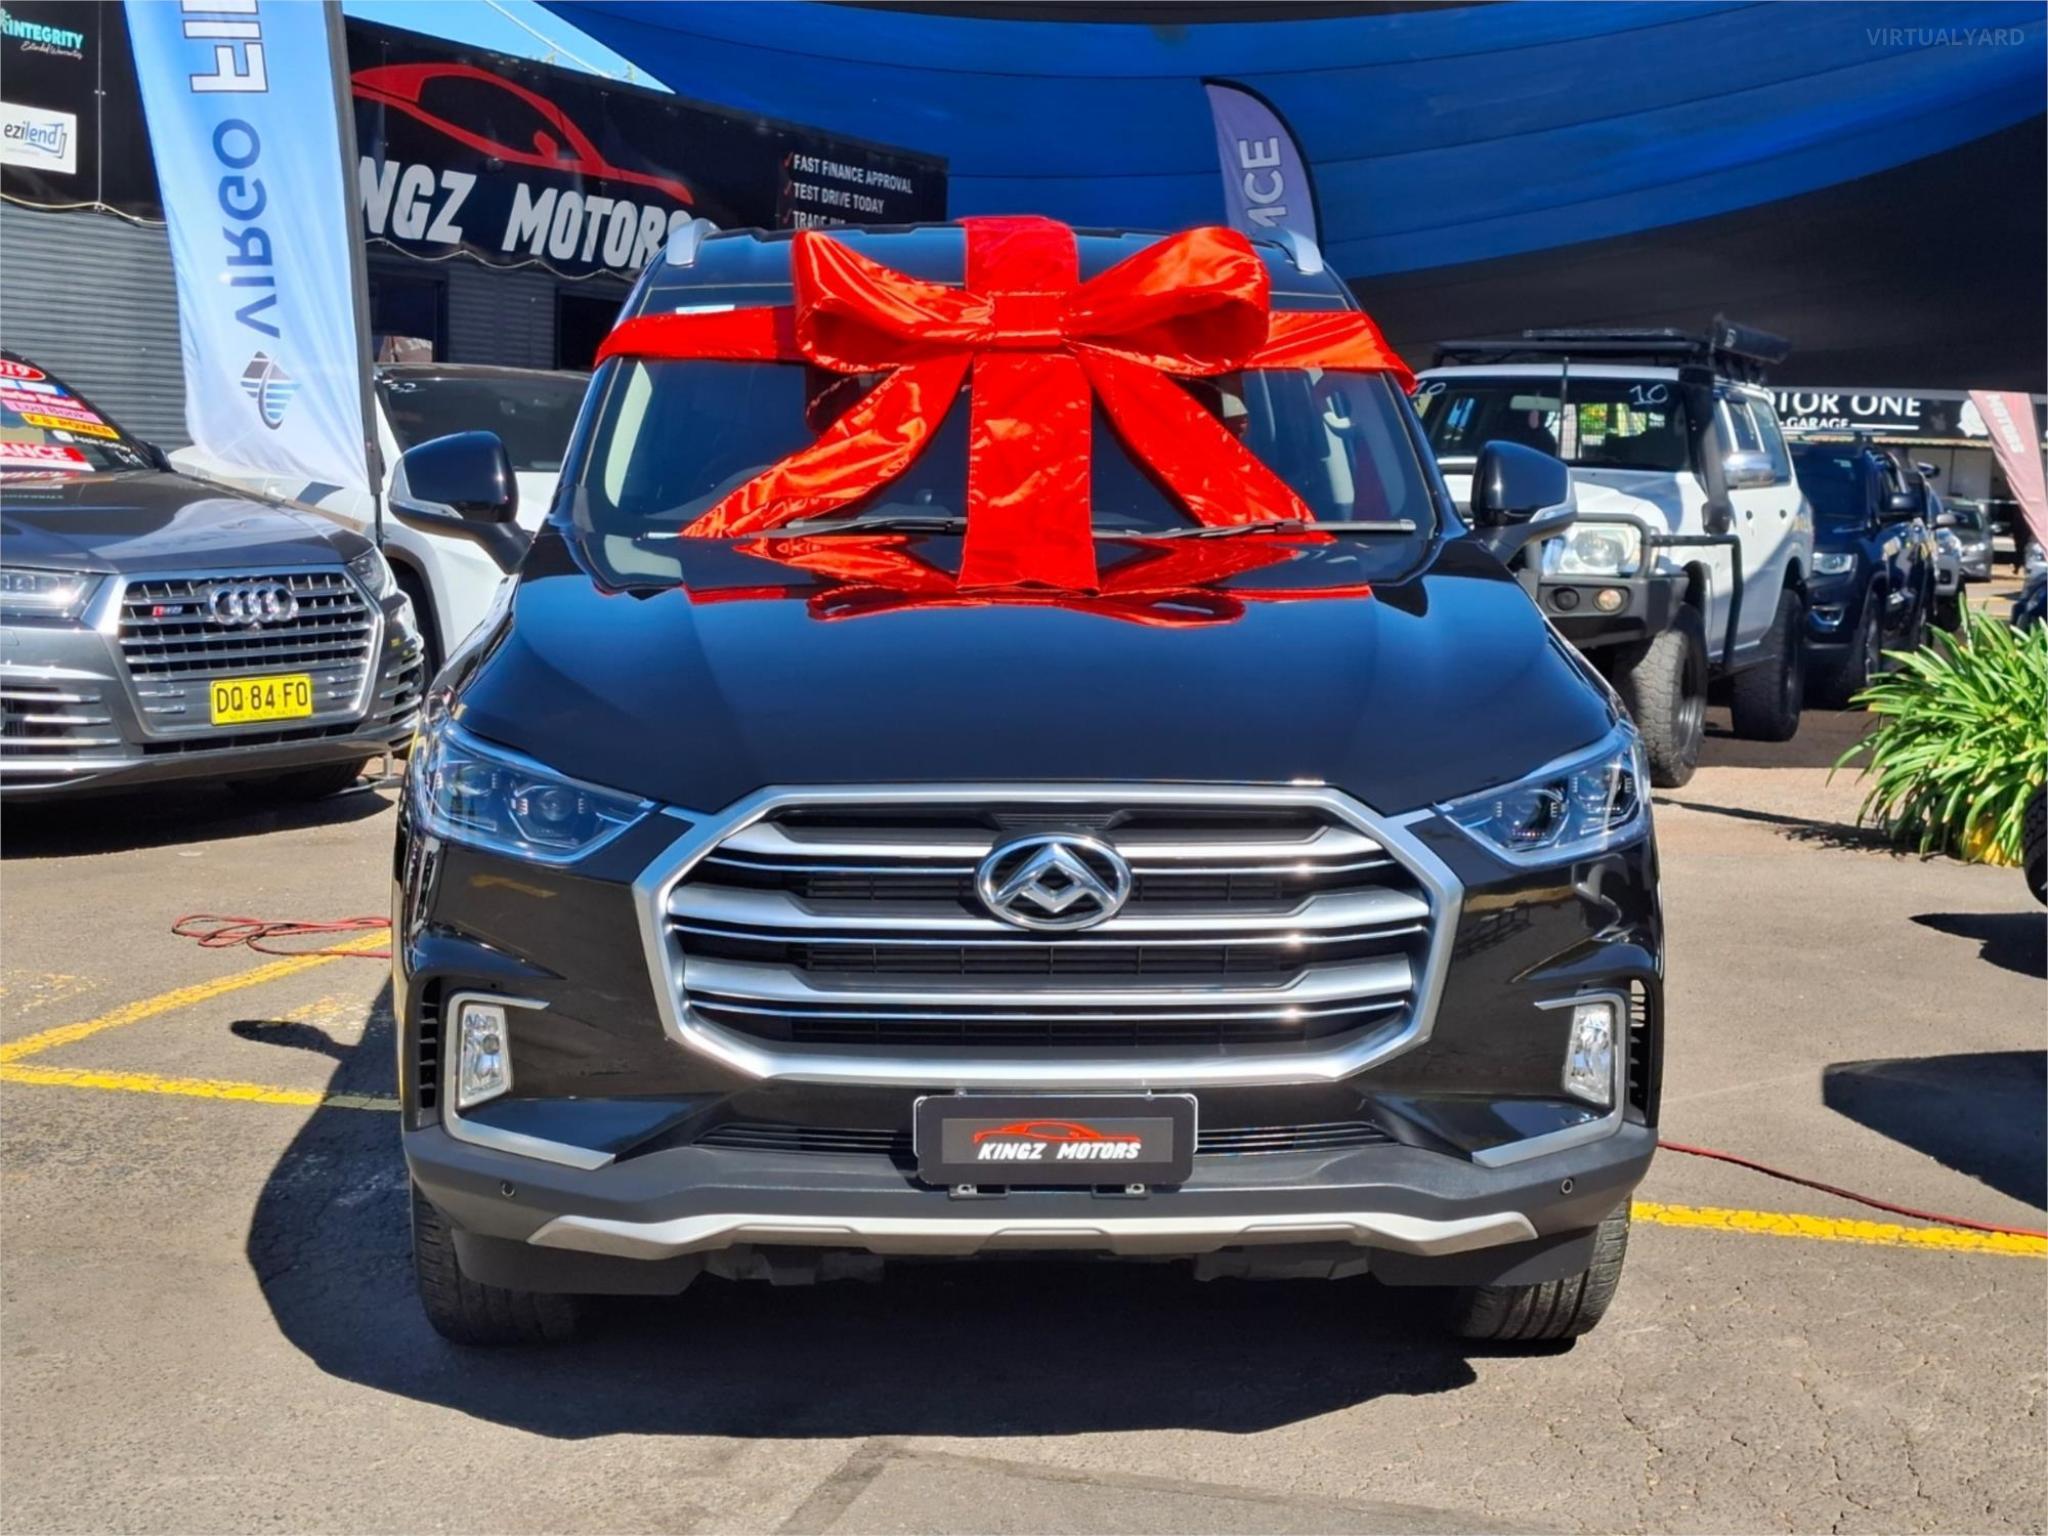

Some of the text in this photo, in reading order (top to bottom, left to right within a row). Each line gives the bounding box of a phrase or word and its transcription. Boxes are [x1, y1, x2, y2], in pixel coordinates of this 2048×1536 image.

[793, 154, 913, 195] FAST FINANCE APPROVAL
[793, 182, 885, 215] TEST DRIVE TODAY
[1629, 383, 1669, 405] 10
[1851, 395, 1921, 417] ONE
[1786, 416, 1849, 429] GARAGE
[216, 686, 243, 713] DQ
[251, 684, 276, 711] 84
[977, 1142, 1142, 1160] KINGZ MOTORS
